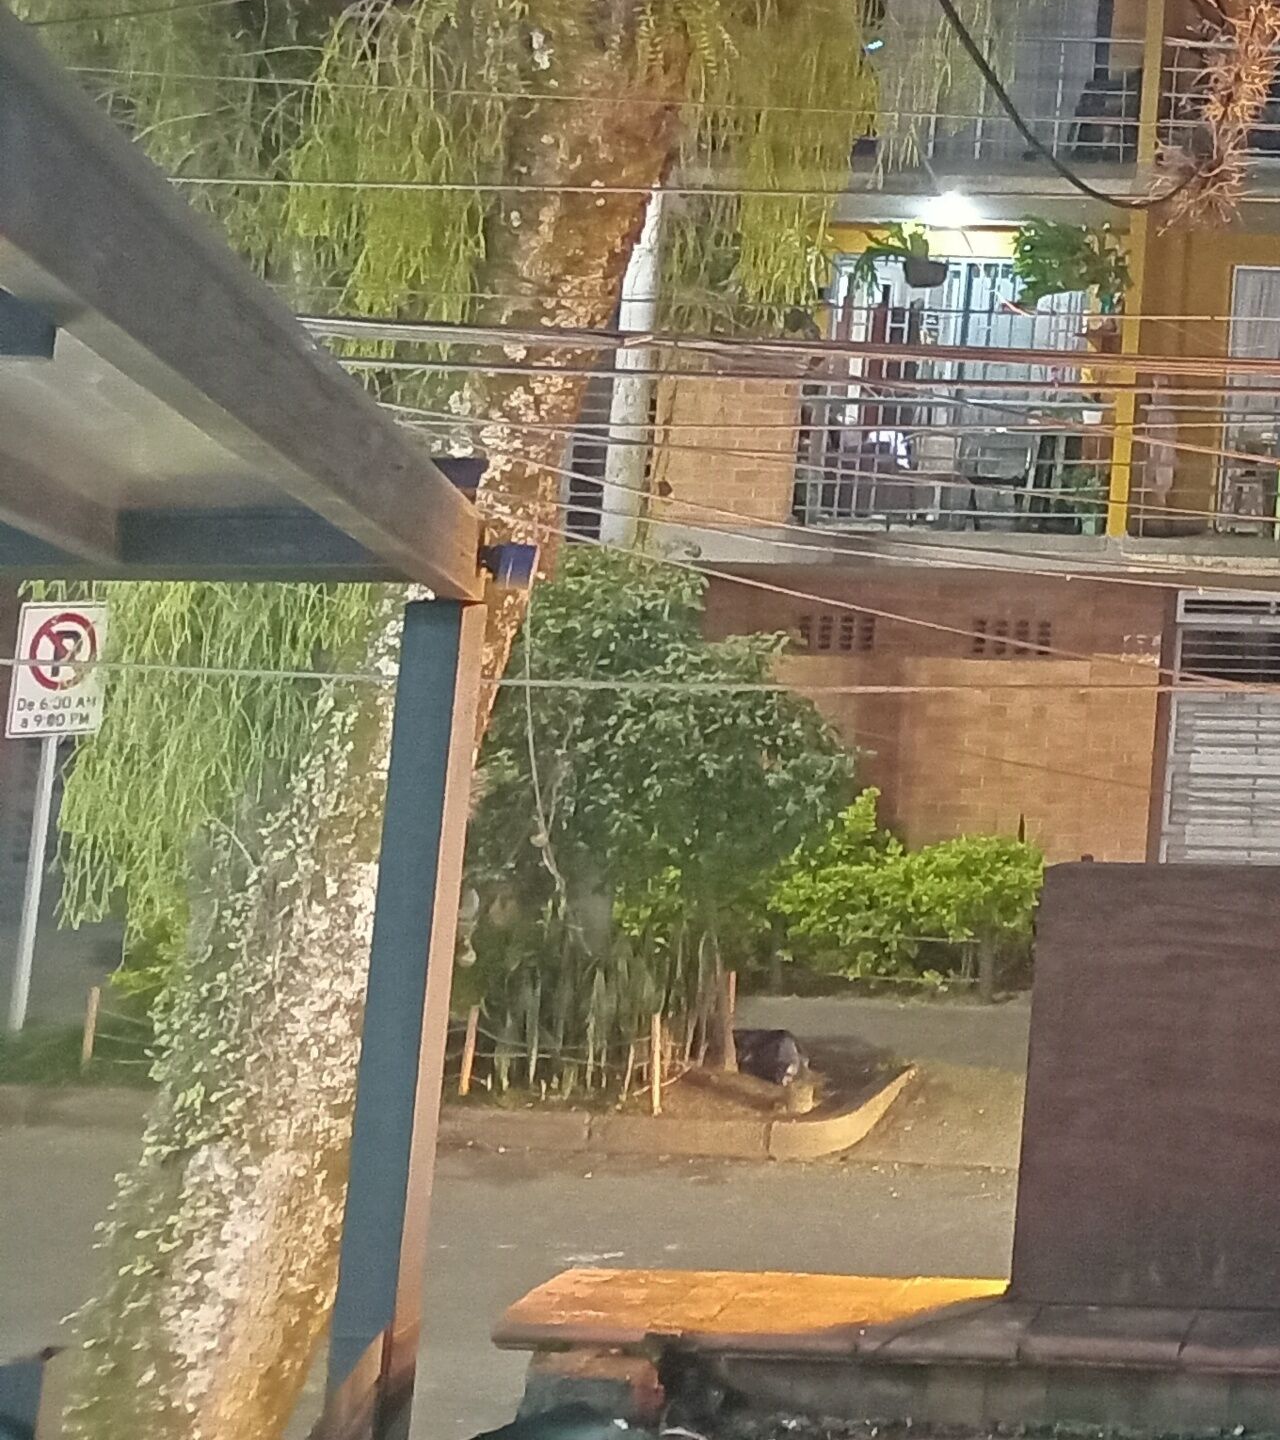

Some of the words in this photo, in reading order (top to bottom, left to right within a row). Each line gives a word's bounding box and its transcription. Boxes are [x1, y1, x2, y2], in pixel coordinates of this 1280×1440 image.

[17, 697, 36, 711] De
[20, 718, 29, 728] a
[70, 712, 90, 725] PM
